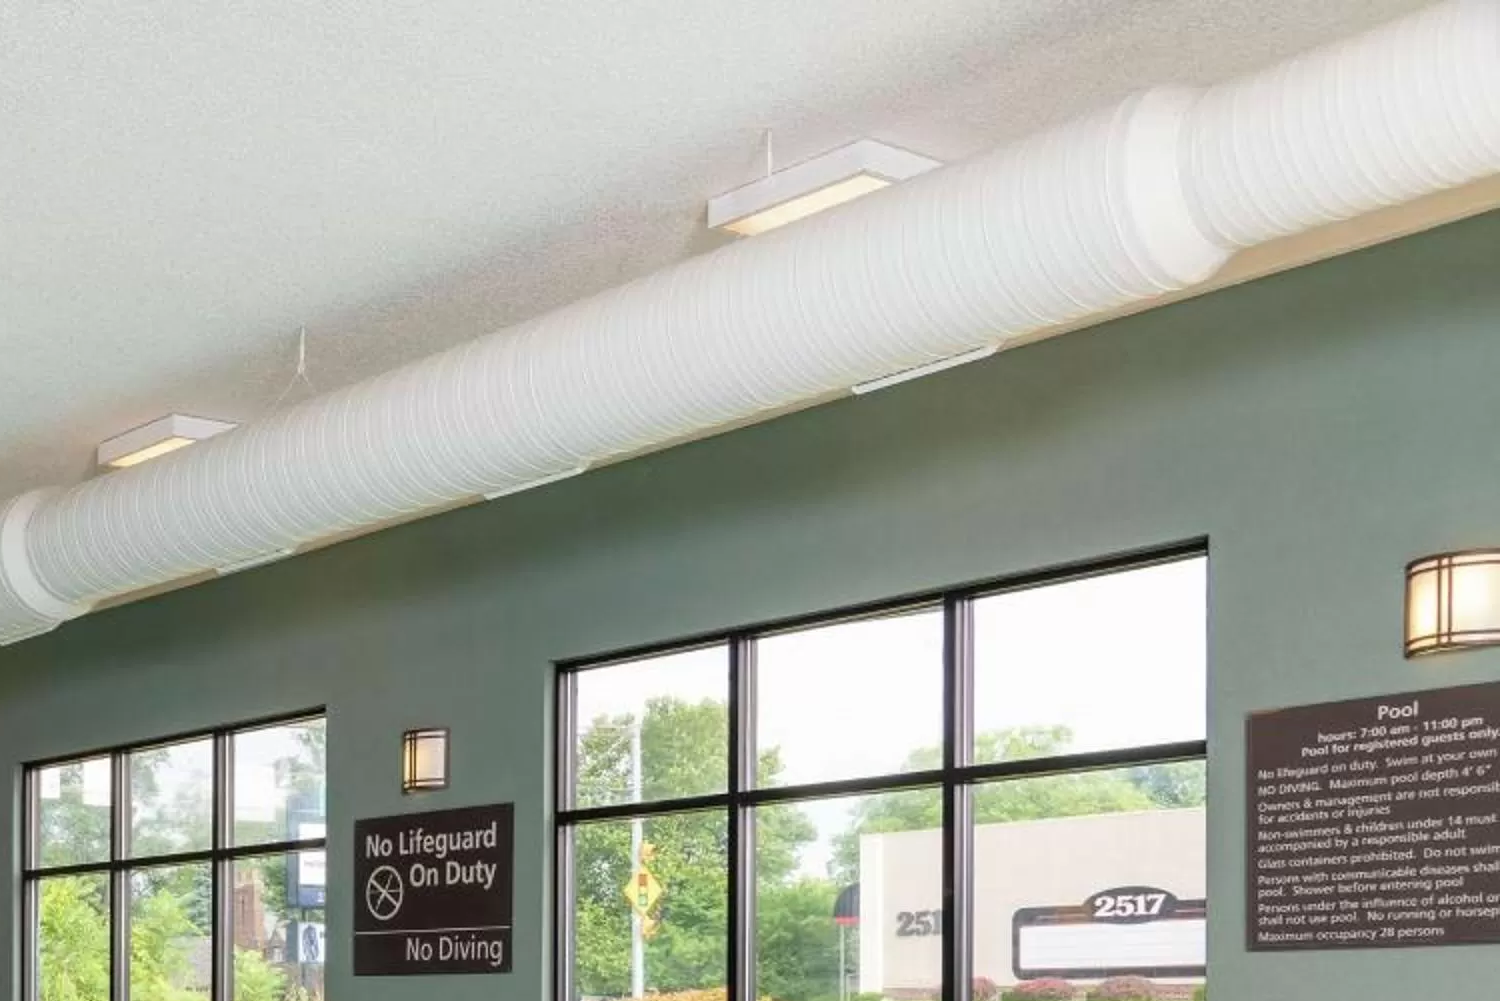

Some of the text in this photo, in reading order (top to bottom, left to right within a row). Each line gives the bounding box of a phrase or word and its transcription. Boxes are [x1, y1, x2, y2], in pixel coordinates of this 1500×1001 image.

[1378, 700, 1418, 720] Pool
[1317, 730, 1357, 743] hours:
[1360, 726, 1387, 738] 7:00
[1389, 725, 1411, 735] am
[1423, 717, 1458, 731] 11:00
[1461, 717, 1484, 729] pm
[1301, 744, 1329, 757] Pool
[1331, 743, 1350, 754] for
[1353, 735, 1419, 753] registered
[1421, 731, 1466, 747] guests
[1258, 769, 1275, 779] No
[1277, 764, 1329, 778] lifeguard
[1385, 756, 1419, 768] Swim
[1421, 754, 1433, 765] at
[1436, 752, 1467, 765] your
[1468, 748, 1498, 759] own
[1258, 785, 1276, 797] NO
[1329, 777, 1388, 790] Maximum
[1391, 772, 1419, 786] pool
[1421, 768, 1459, 782] depth
[1257, 800, 1301, 813] Owners
[1303, 797, 1313, 809] &
[1315, 791, 1392, 807] management
[1395, 791, 1417, 801] are
[1418, 787, 1440, 799] not
[1258, 813, 1275, 824] for
[1277, 808, 1329, 822] accidents
[1331, 809, 1345, 819] or
[1258, 813, 1498, 841] Non-swimmers & children under 14 must
[365, 821, 497, 859] No Lifeguard
[1257, 838, 1332, 853] accompanied
[1334, 836, 1349, 850] by
[1351, 838, 1359, 847] a
[1361, 830, 1430, 846] responsible
[1258, 859, 1286, 869] Glass
[1288, 855, 1348, 868] containers
[1423, 847, 1442, 859] Do
[1444, 846, 1467, 858] not
[409, 860, 497, 890] On Duty
[1258, 875, 1300, 885] Persons
[1301, 871, 1329, 883] with
[1331, 866, 1418, 880] communicable
[1419, 864, 1470, 877] diseases
[1292, 885, 1335, 896] Shower
[1337, 881, 1378, 893] before
[1379, 879, 1433, 891] entering
[1094, 893, 1167, 917] 2517
[1258, 903, 1300, 913] Persons
[1301, 900, 1337, 911] under
[1339, 900, 1359, 910] the
[1361, 896, 1418, 908] influence
[1421, 893, 1434, 907] of
[1437, 891, 1483, 905] alcohol
[896, 909, 942, 937] 251
[1258, 914, 1283, 925] shall
[1285, 914, 1307, 925] not
[1308, 915, 1328, 925] use
[1367, 911, 1385, 921] No
[1387, 909, 1436, 921] running
[1438, 908, 1453, 919] or
[1258, 927, 1445, 941] Maximum occupancy 28 persons
[406, 935, 503, 967] No Diving
